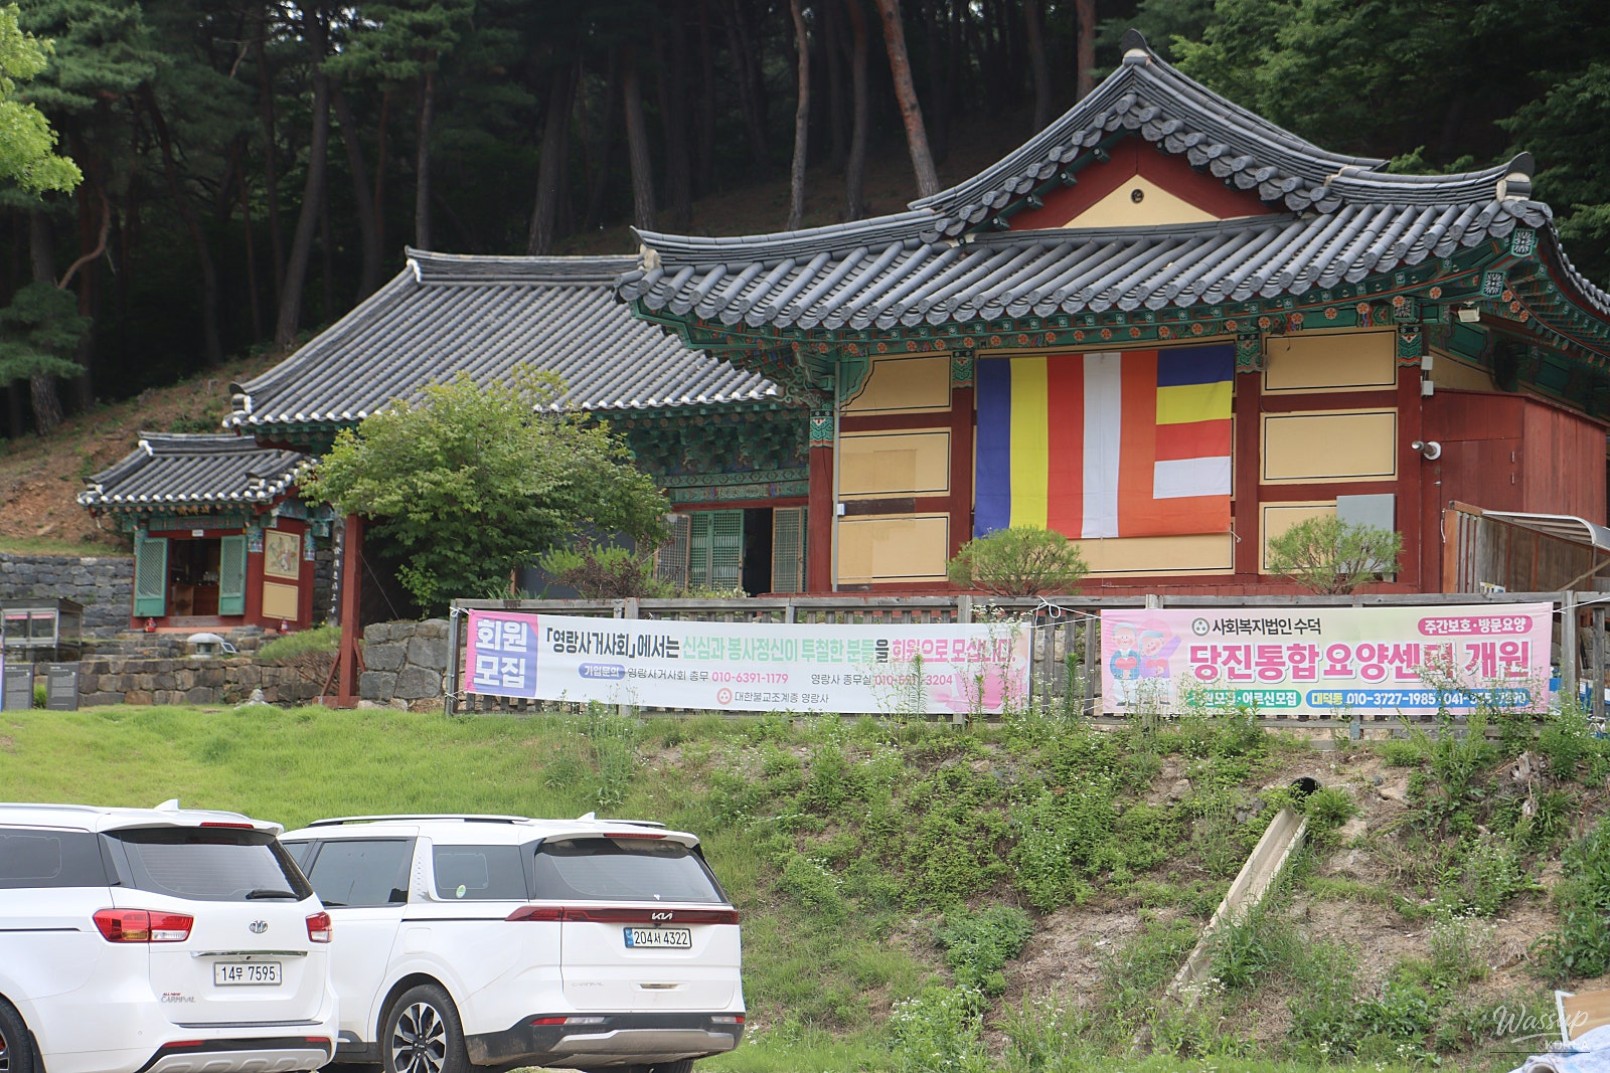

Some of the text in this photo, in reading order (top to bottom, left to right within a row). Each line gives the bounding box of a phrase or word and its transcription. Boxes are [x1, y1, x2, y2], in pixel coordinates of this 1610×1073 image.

[475, 619, 528, 653] 회원
[1212, 618, 1321, 636] 사회복지법인 수덕
[682, 636, 725, 660] 신심과
[728, 637, 798, 662] 봉사정신이
[801, 638, 845, 663] 투철한
[892, 639, 948, 663] 회원으로
[1189, 641, 1530, 681] 당진통합 요양센터 개원
[473, 654, 526, 689] 모집
[628, 667, 687, 681] 영랑사거사회
[712, 671, 789, 684] 010-6391-1179
[811, 673, 841, 685] 영랑사
[843, 674, 872, 686] 종무실
[734, 691, 829, 704] 대한불교조계종 영랑사
[1311, 692, 1343, 705] 대덕동
[1346, 692, 1436, 705] 010-3727-1985
[663, 932, 688, 945] 4322
[221, 966, 276, 981] 14무 7595
